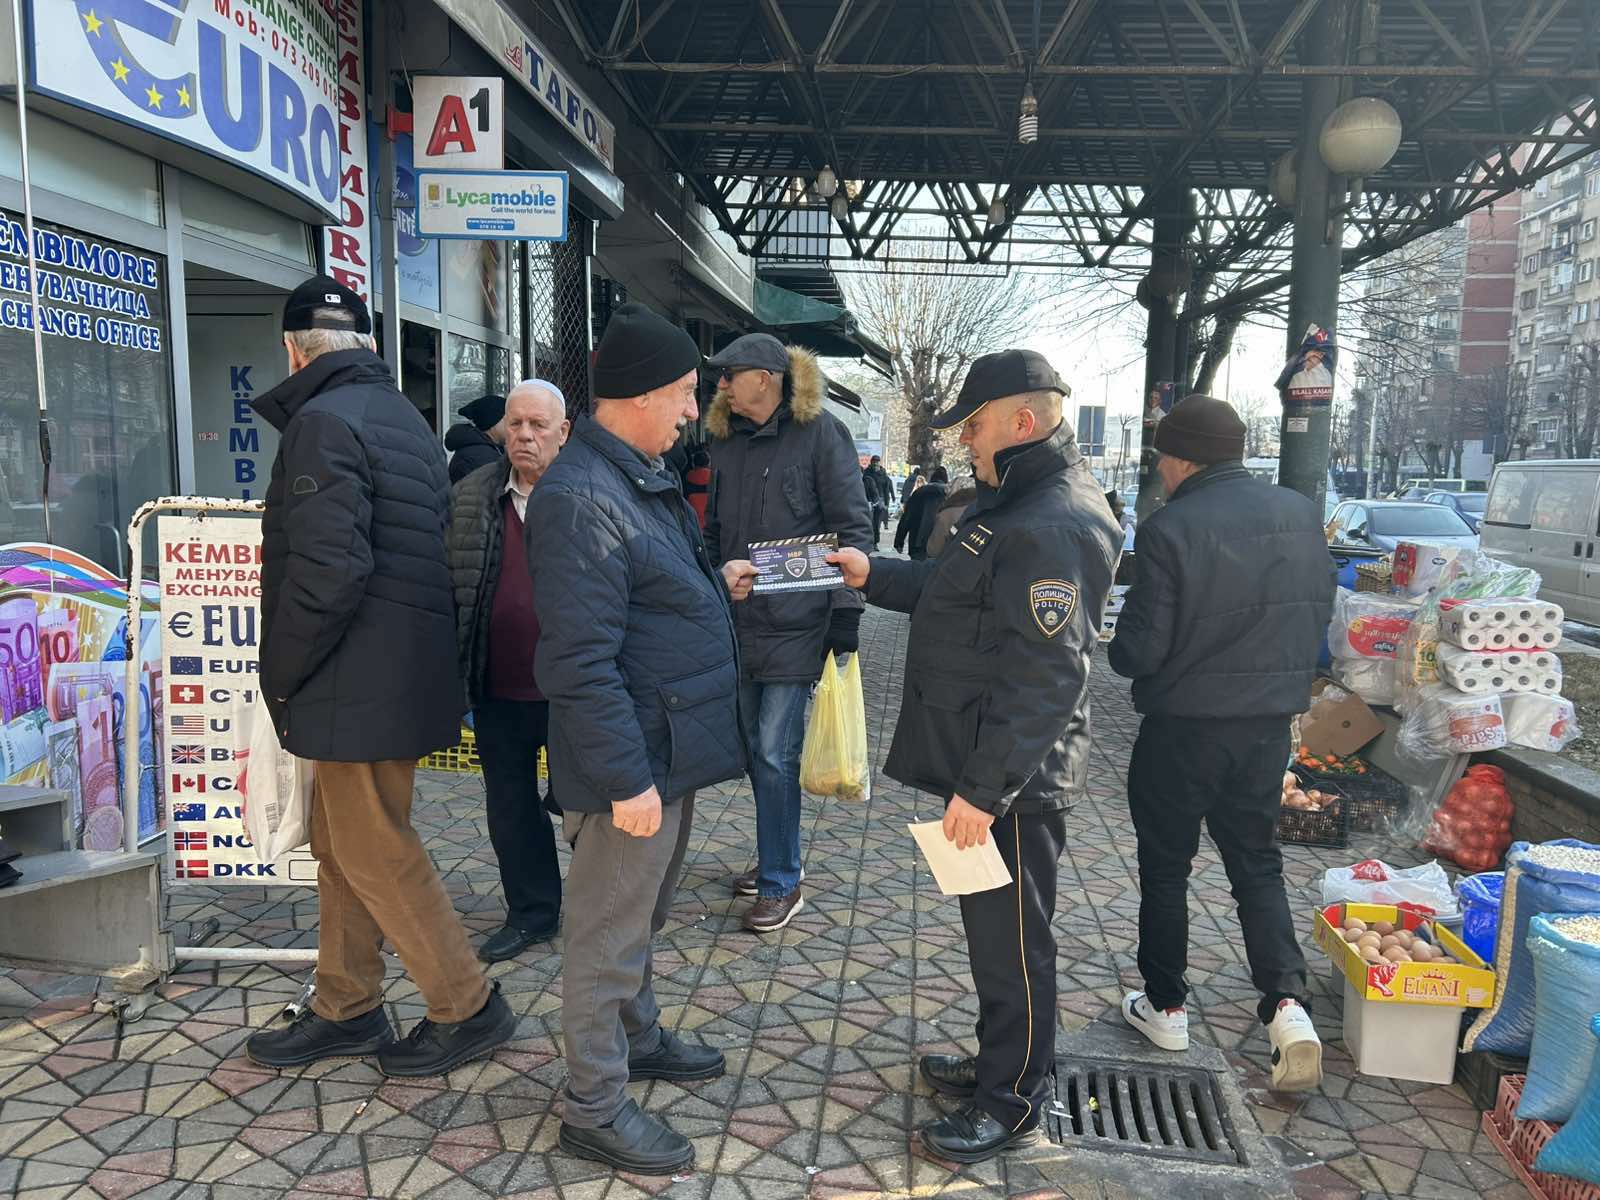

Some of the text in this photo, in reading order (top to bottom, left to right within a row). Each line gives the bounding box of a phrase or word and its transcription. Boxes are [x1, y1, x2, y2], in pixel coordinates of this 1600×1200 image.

[271, 30, 297, 66] 073
[301, 54, 320, 88] 209
[446, 187, 556, 207] Lycamobile
[490, 206, 504, 214] Call
[0, 298, 161, 352] CHANGE OFFICE
[1033, 590, 1072, 603] ПОЛИЦИЈА
[1034, 601, 1070, 613] POLICE
[40, 631, 70, 664] 10
[213, 863, 277, 877] DKK
